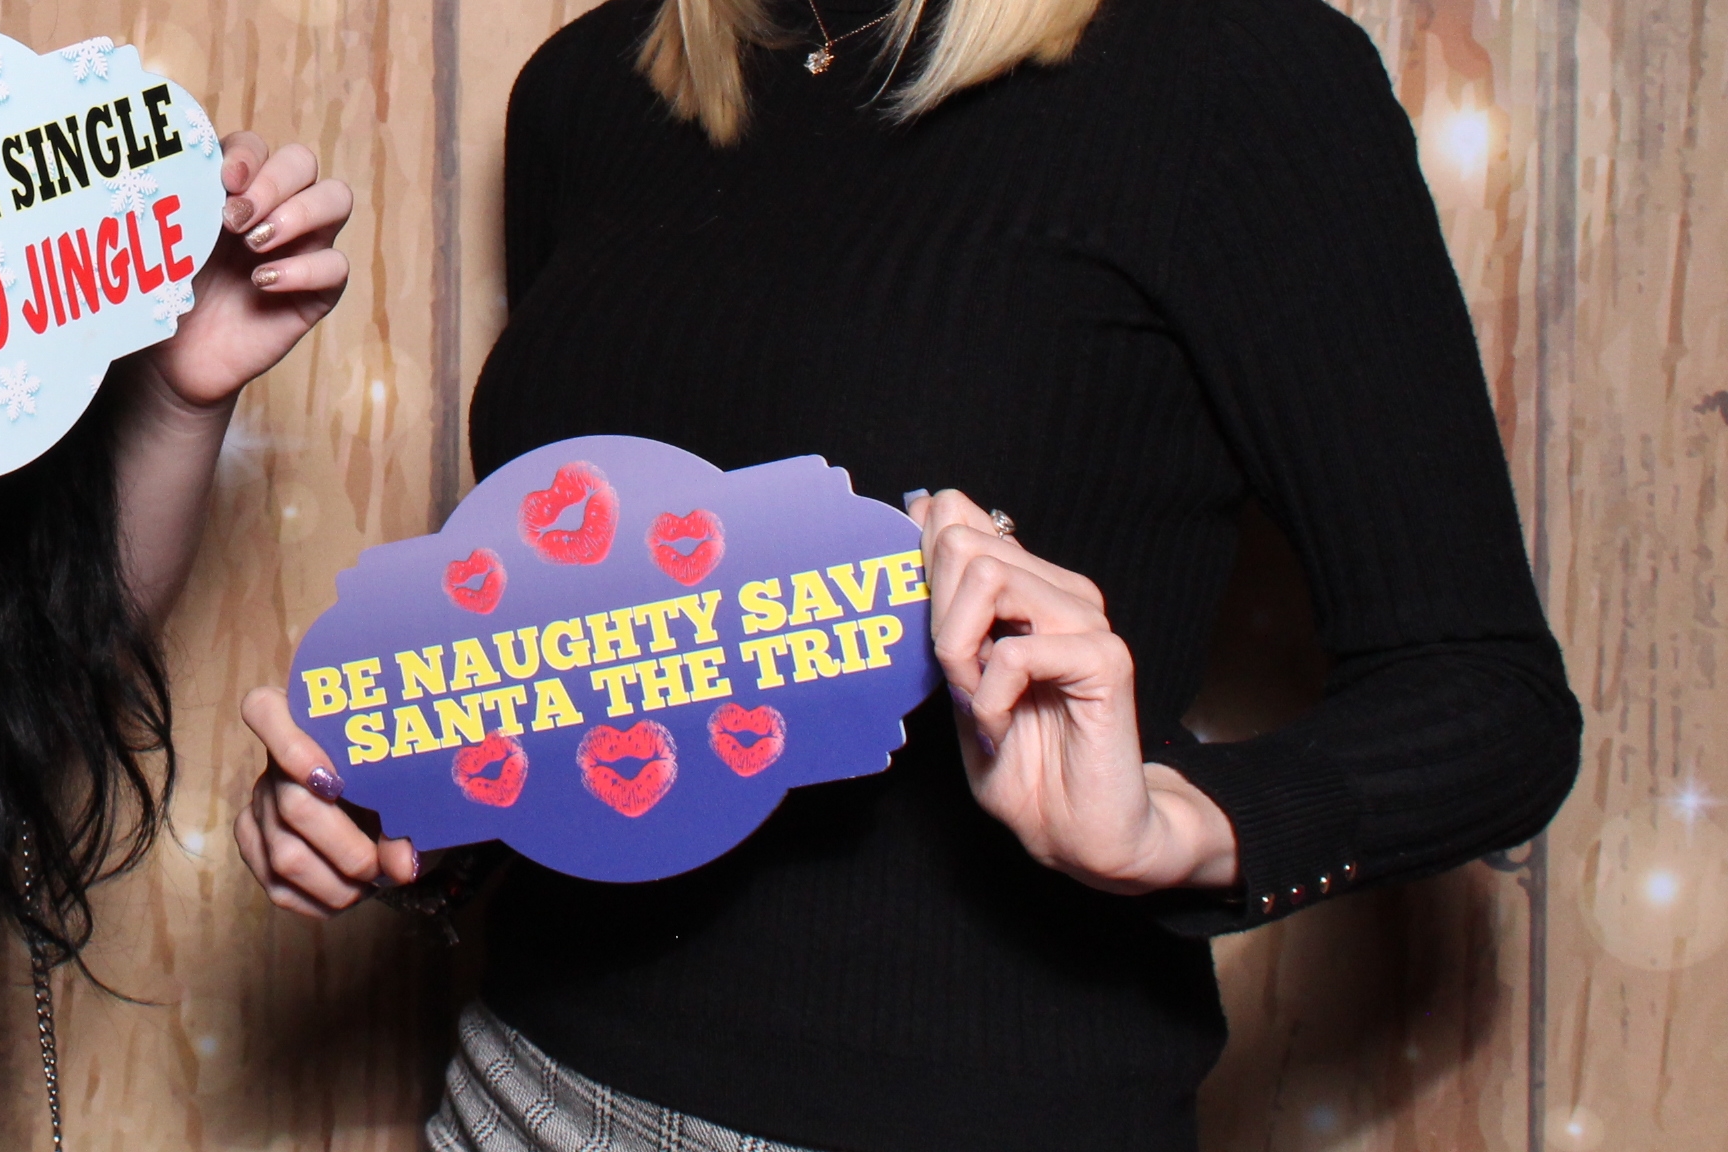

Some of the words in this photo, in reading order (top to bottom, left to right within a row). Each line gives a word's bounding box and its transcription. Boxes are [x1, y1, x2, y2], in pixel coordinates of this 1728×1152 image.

[0, 83, 183, 212] SINGLE
[22, 194, 194, 335] JINGLE
[301, 657, 387, 718] BE
[394, 589, 723, 702] NAUGHTY
[737, 549, 931, 635] SAVE
[344, 678, 583, 765] SANTA
[590, 646, 731, 719] THE
[742, 614, 903, 690] TRIP
